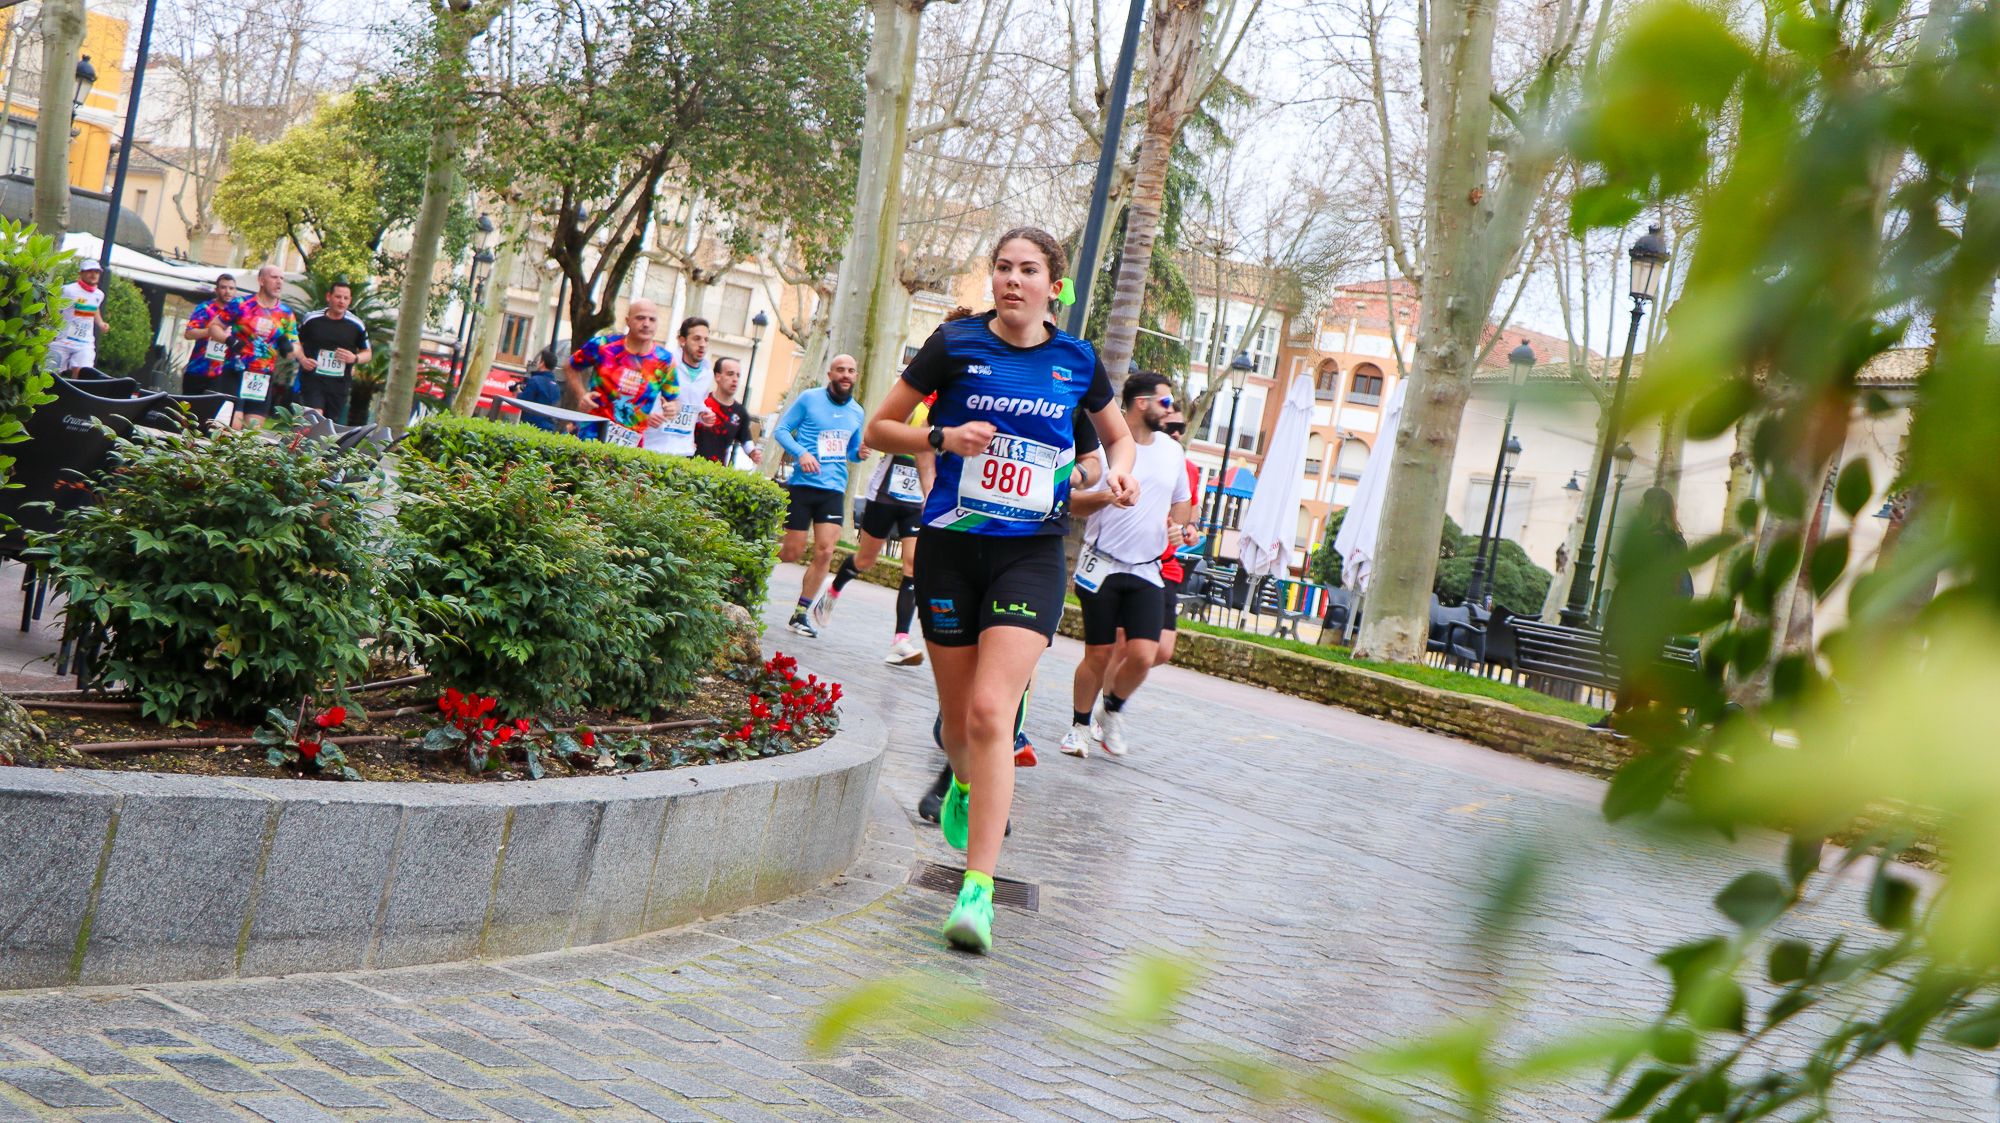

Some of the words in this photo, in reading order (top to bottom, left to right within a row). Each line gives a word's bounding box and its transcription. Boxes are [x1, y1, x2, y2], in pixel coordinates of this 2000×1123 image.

[966, 394, 1065, 419] enerplus
[902, 478, 917, 491] 92
[981, 459, 1032, 497] 980
